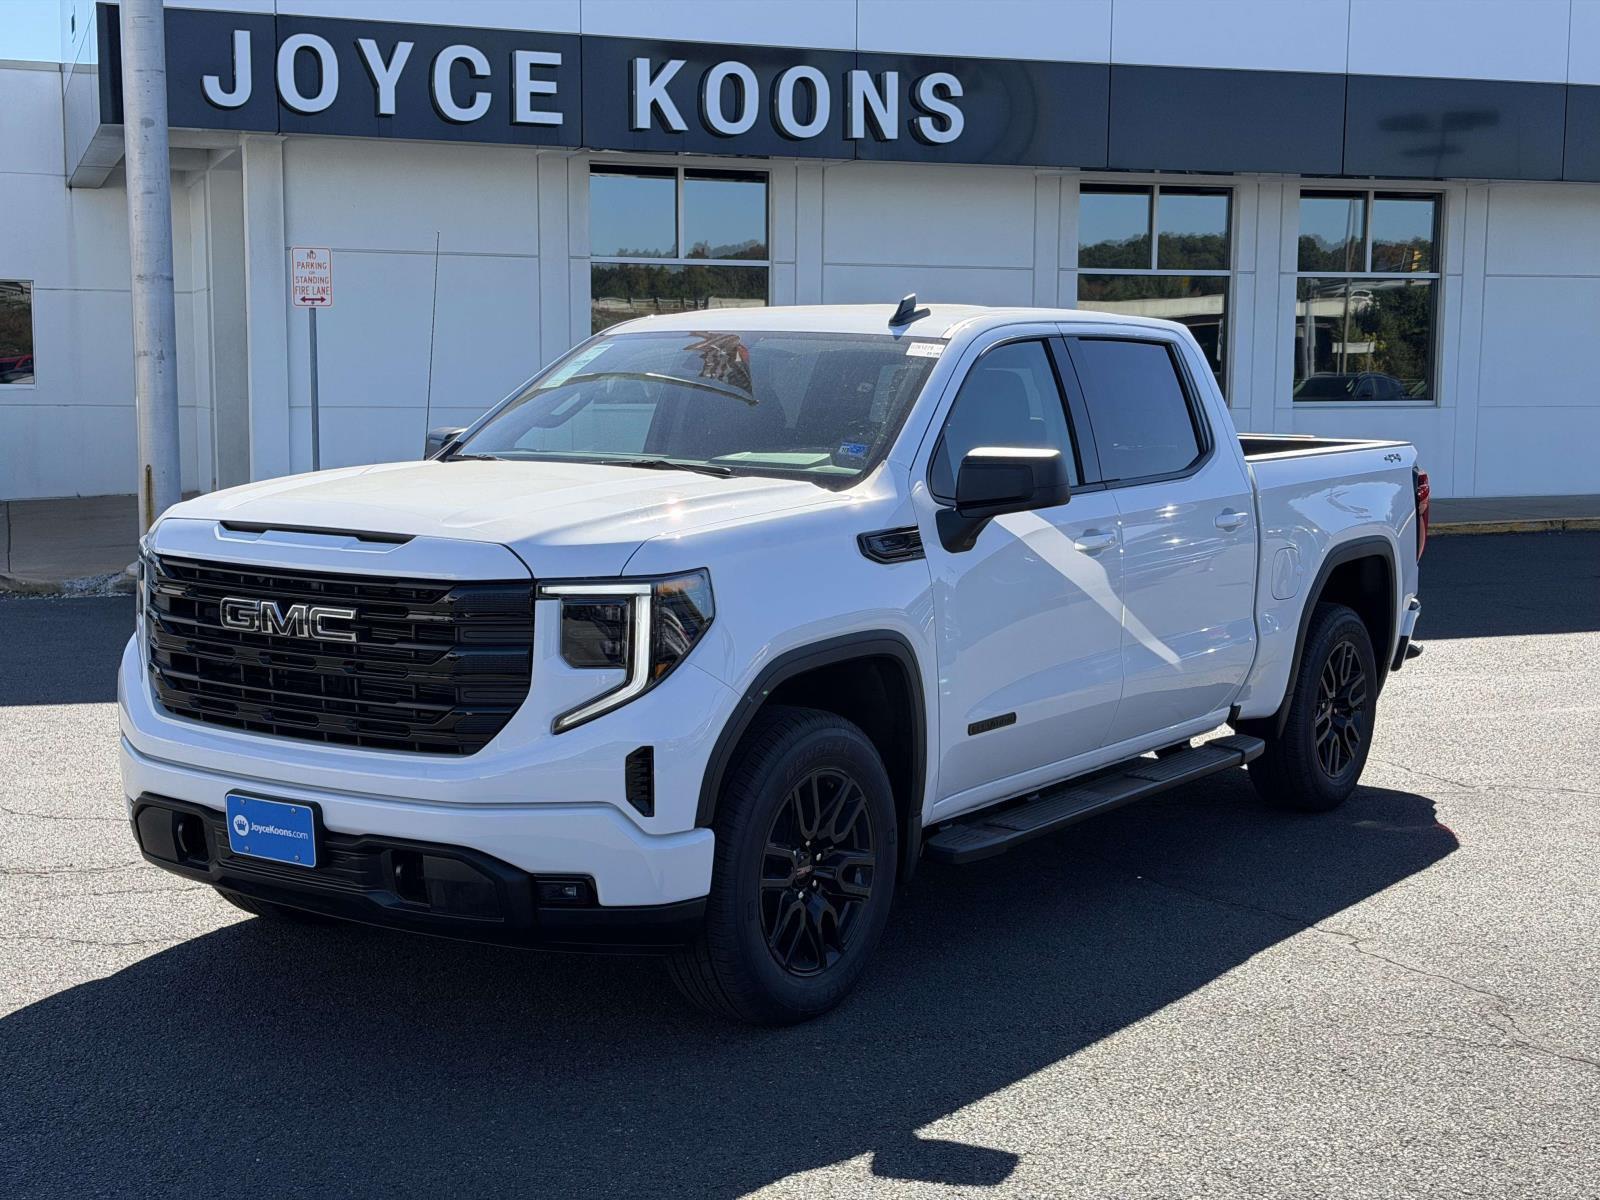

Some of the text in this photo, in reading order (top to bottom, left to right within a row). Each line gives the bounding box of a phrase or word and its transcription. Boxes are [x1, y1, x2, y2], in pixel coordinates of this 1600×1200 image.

[202, 29, 965, 144] JOYCE KOONS
[306, 251, 316, 260] NO
[296, 262, 327, 270] PARKING
[295, 276, 329, 285] STANDING
[294, 285, 330, 295] FIRE LANE
[220, 597, 358, 642] GMC
[250, 821, 309, 840] JoyceKoons.com
